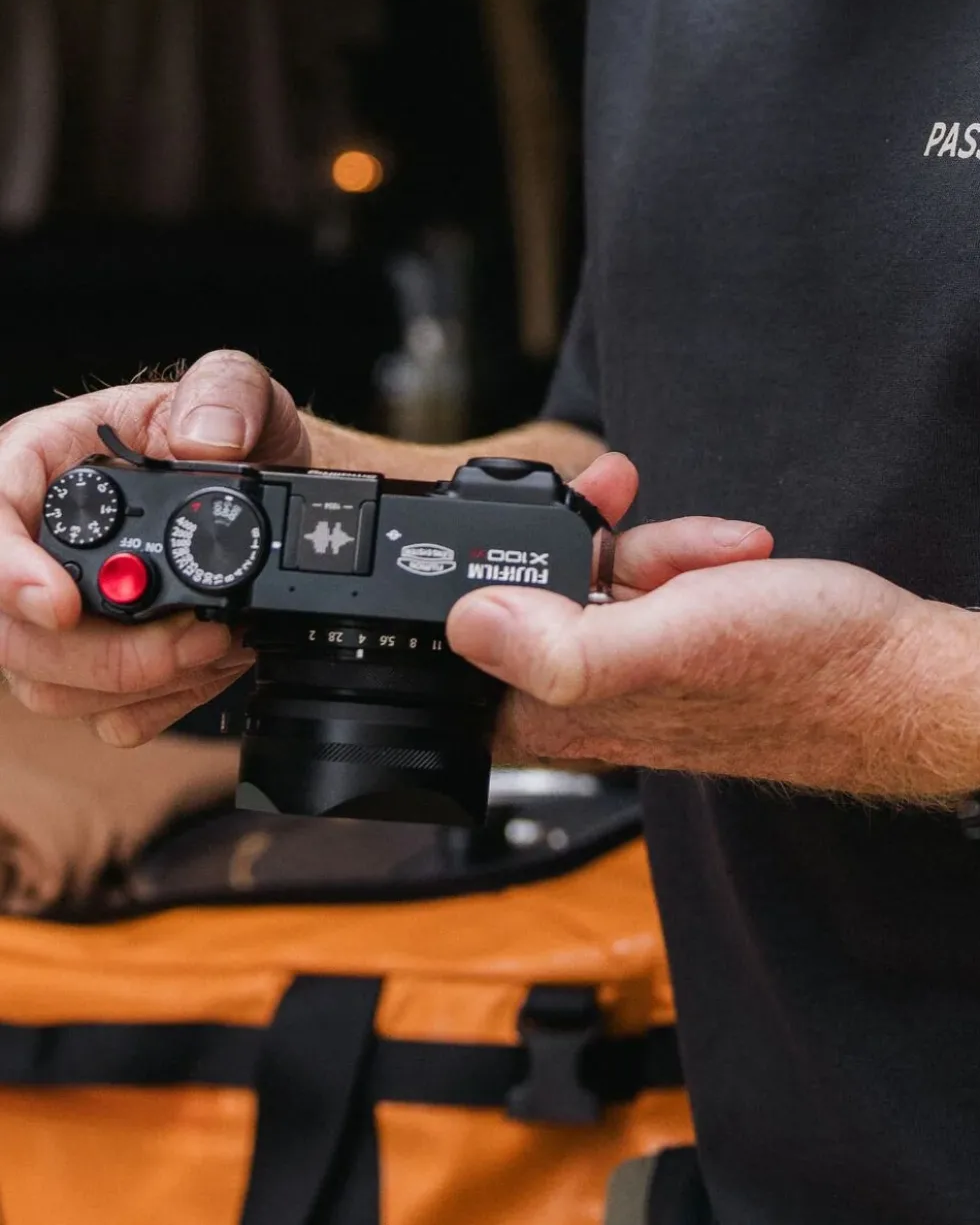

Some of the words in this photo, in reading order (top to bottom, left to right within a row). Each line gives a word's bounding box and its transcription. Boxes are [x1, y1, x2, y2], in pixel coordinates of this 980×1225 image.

[119, 537, 142, 549] OFF
[145, 542, 164, 553] ON
[467, 562, 549, 585] FUJIFILM
[308, 630, 317, 641] 2
[358, 634, 367, 645] 4
[409, 638, 419, 649] 8
